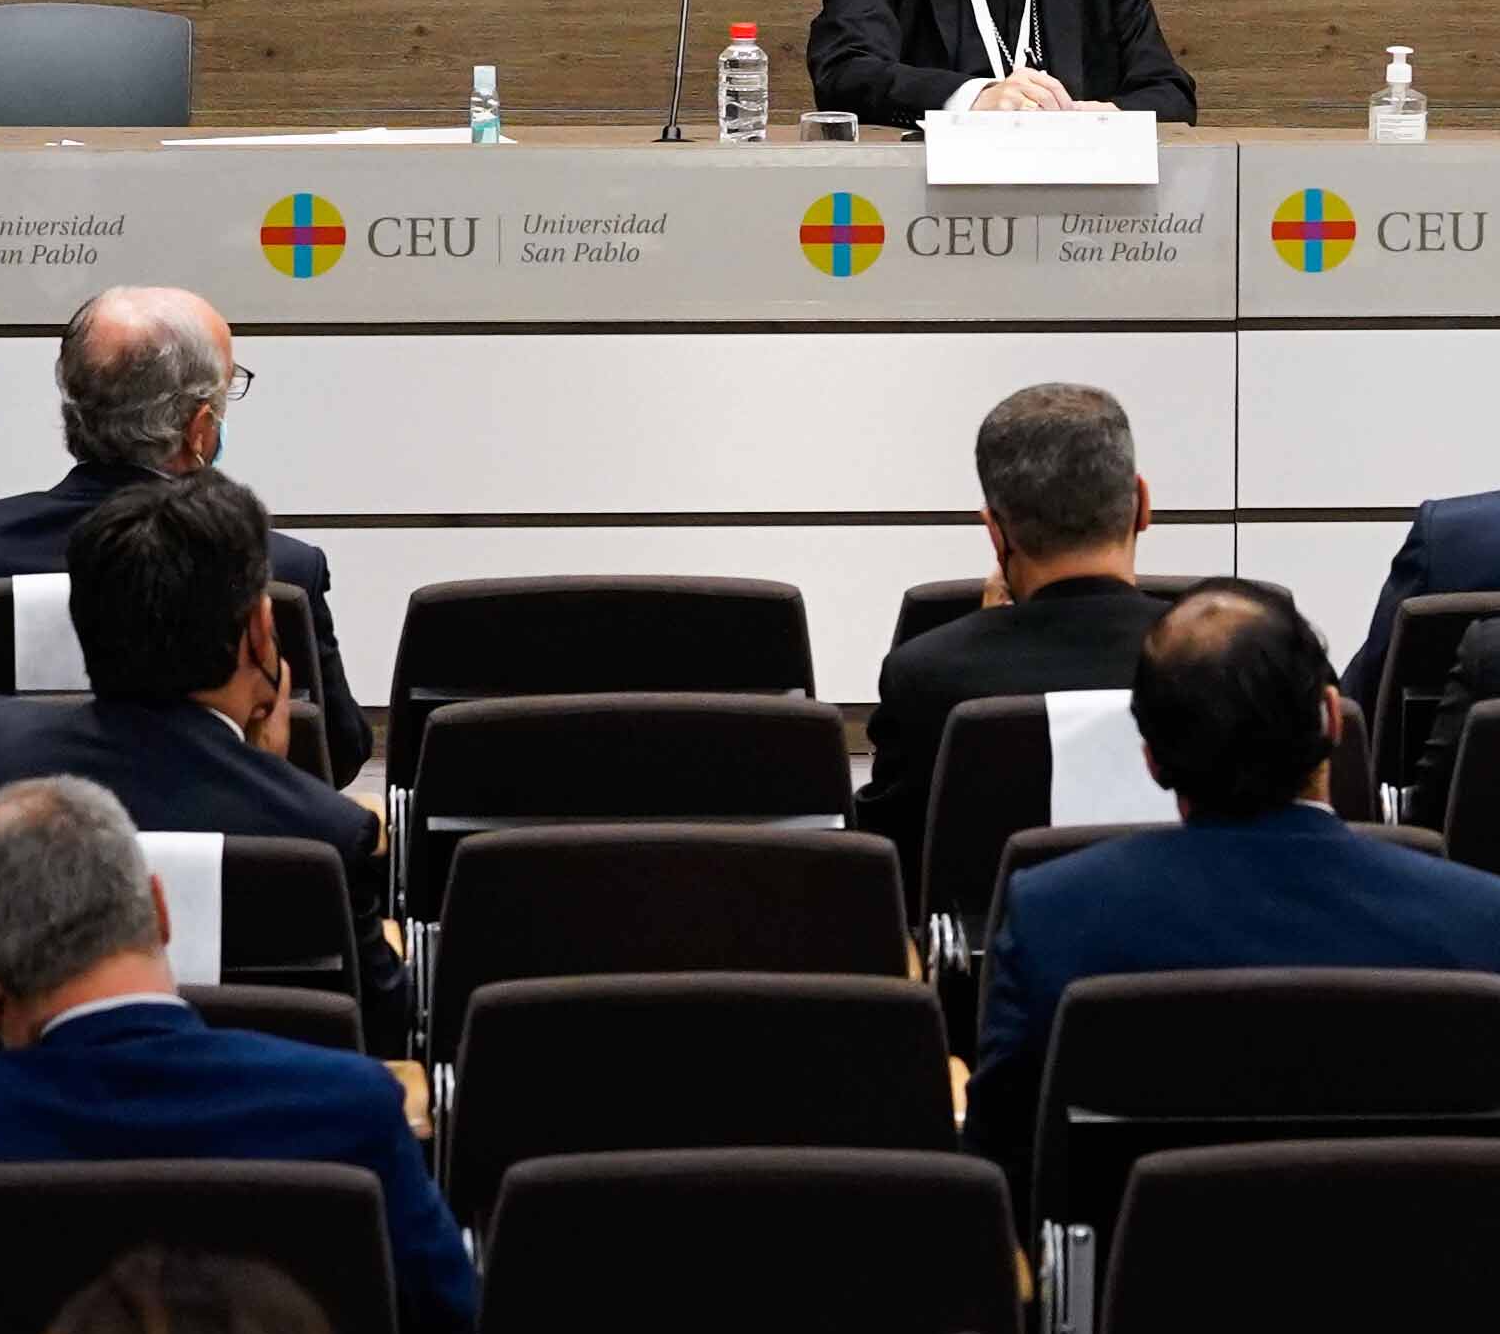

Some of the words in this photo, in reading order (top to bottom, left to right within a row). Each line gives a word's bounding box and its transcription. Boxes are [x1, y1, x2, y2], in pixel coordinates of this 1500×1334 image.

[523, 213, 667, 234] Universidad
[1060, 213, 1204, 233] Universidad
[1377, 212, 1488, 251] CEU
[367, 217, 481, 257] CEU
[906, 216, 1019, 256] CEU
[30, 244, 97, 264] Pablo
[521, 242, 565, 263] San
[572, 242, 640, 263] Pablo
[1058, 241, 1103, 262] San
[1110, 241, 1177, 262] Pablo
